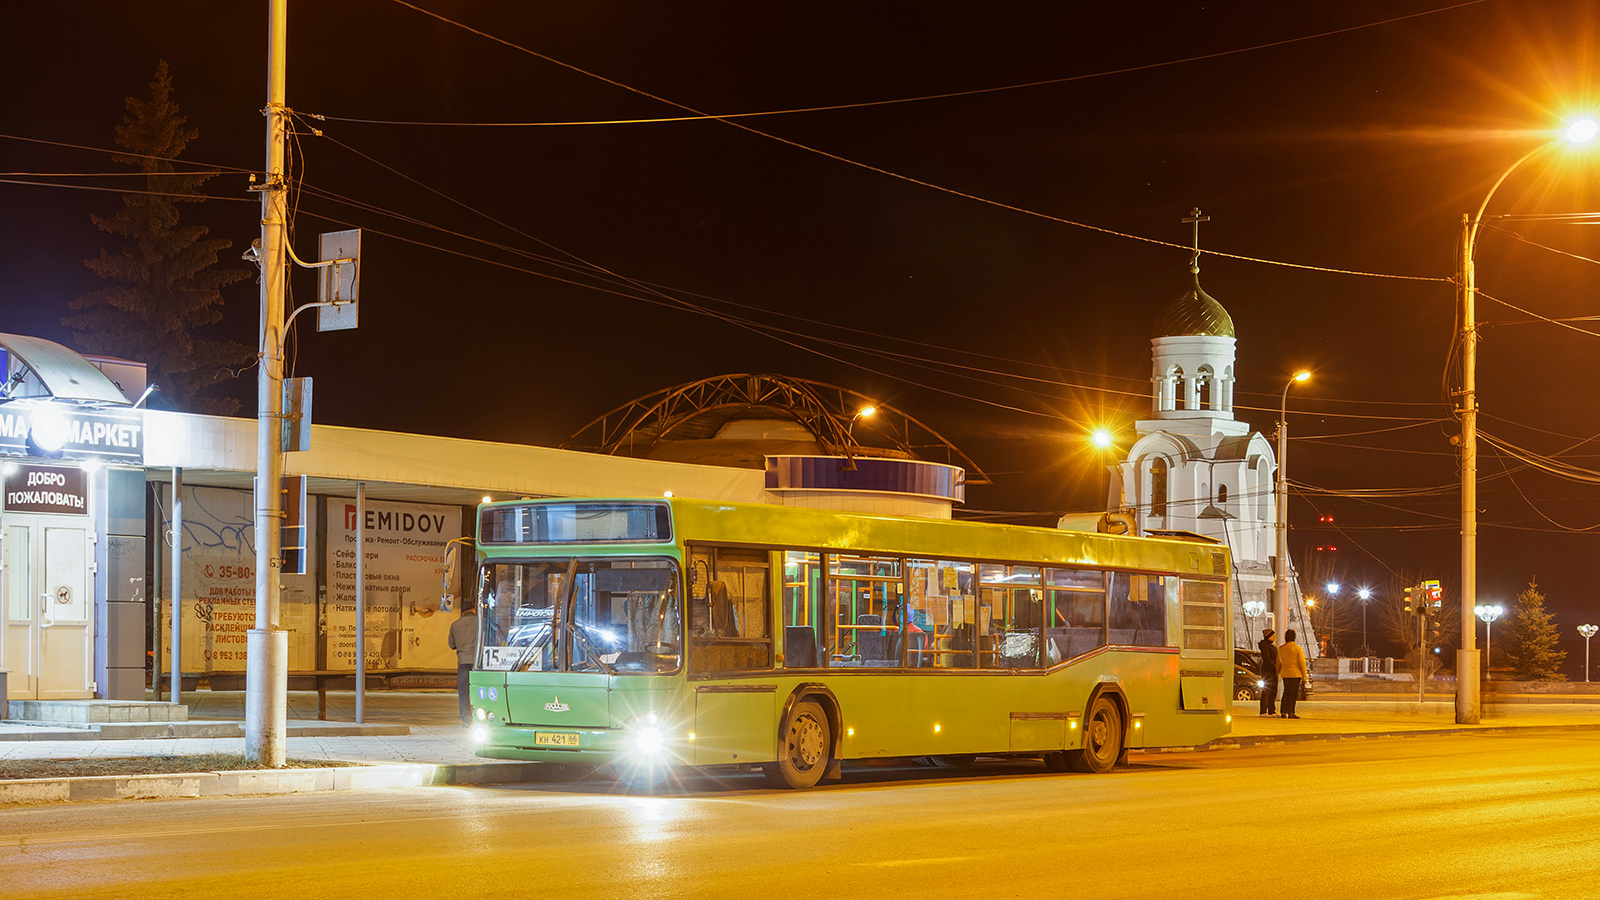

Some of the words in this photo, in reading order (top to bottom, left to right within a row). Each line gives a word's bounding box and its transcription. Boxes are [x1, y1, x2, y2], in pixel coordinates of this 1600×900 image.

[66, 420, 140, 447] МАРКЕТ
[27, 472, 65, 486] ДОБРО
[8, 491, 84, 508] ПОЖАЛОВАТЬ!
[345, 534, 373, 542] Прожа
[376, 536, 400, 544] Ремонт
[403, 538, 447, 547] Обслуживание
[406, 554, 439, 562] РАССРОЧКА
[219, 566, 256, 579] 35-80-
[336, 571, 382, 580] Пластовые
[209, 587, 223, 596] ДЛЯ
[224, 588, 251, 596] РАБОТЫ
[336, 582, 389, 592] Межкнатные
[390, 585, 411, 593] двери
[199, 596, 241, 605] РЕКЛАМНЫХ
[205, 622, 256, 632] РАСКЛЕЙЩИ
[215, 634, 247, 643] ЛИСТОВ
[213, 651, 218, 659] 8
[219, 651, 233, 659] 952
[235, 651, 247, 660] 138
[485, 649, 499, 666] 15
[551, 735, 565, 744] 421
